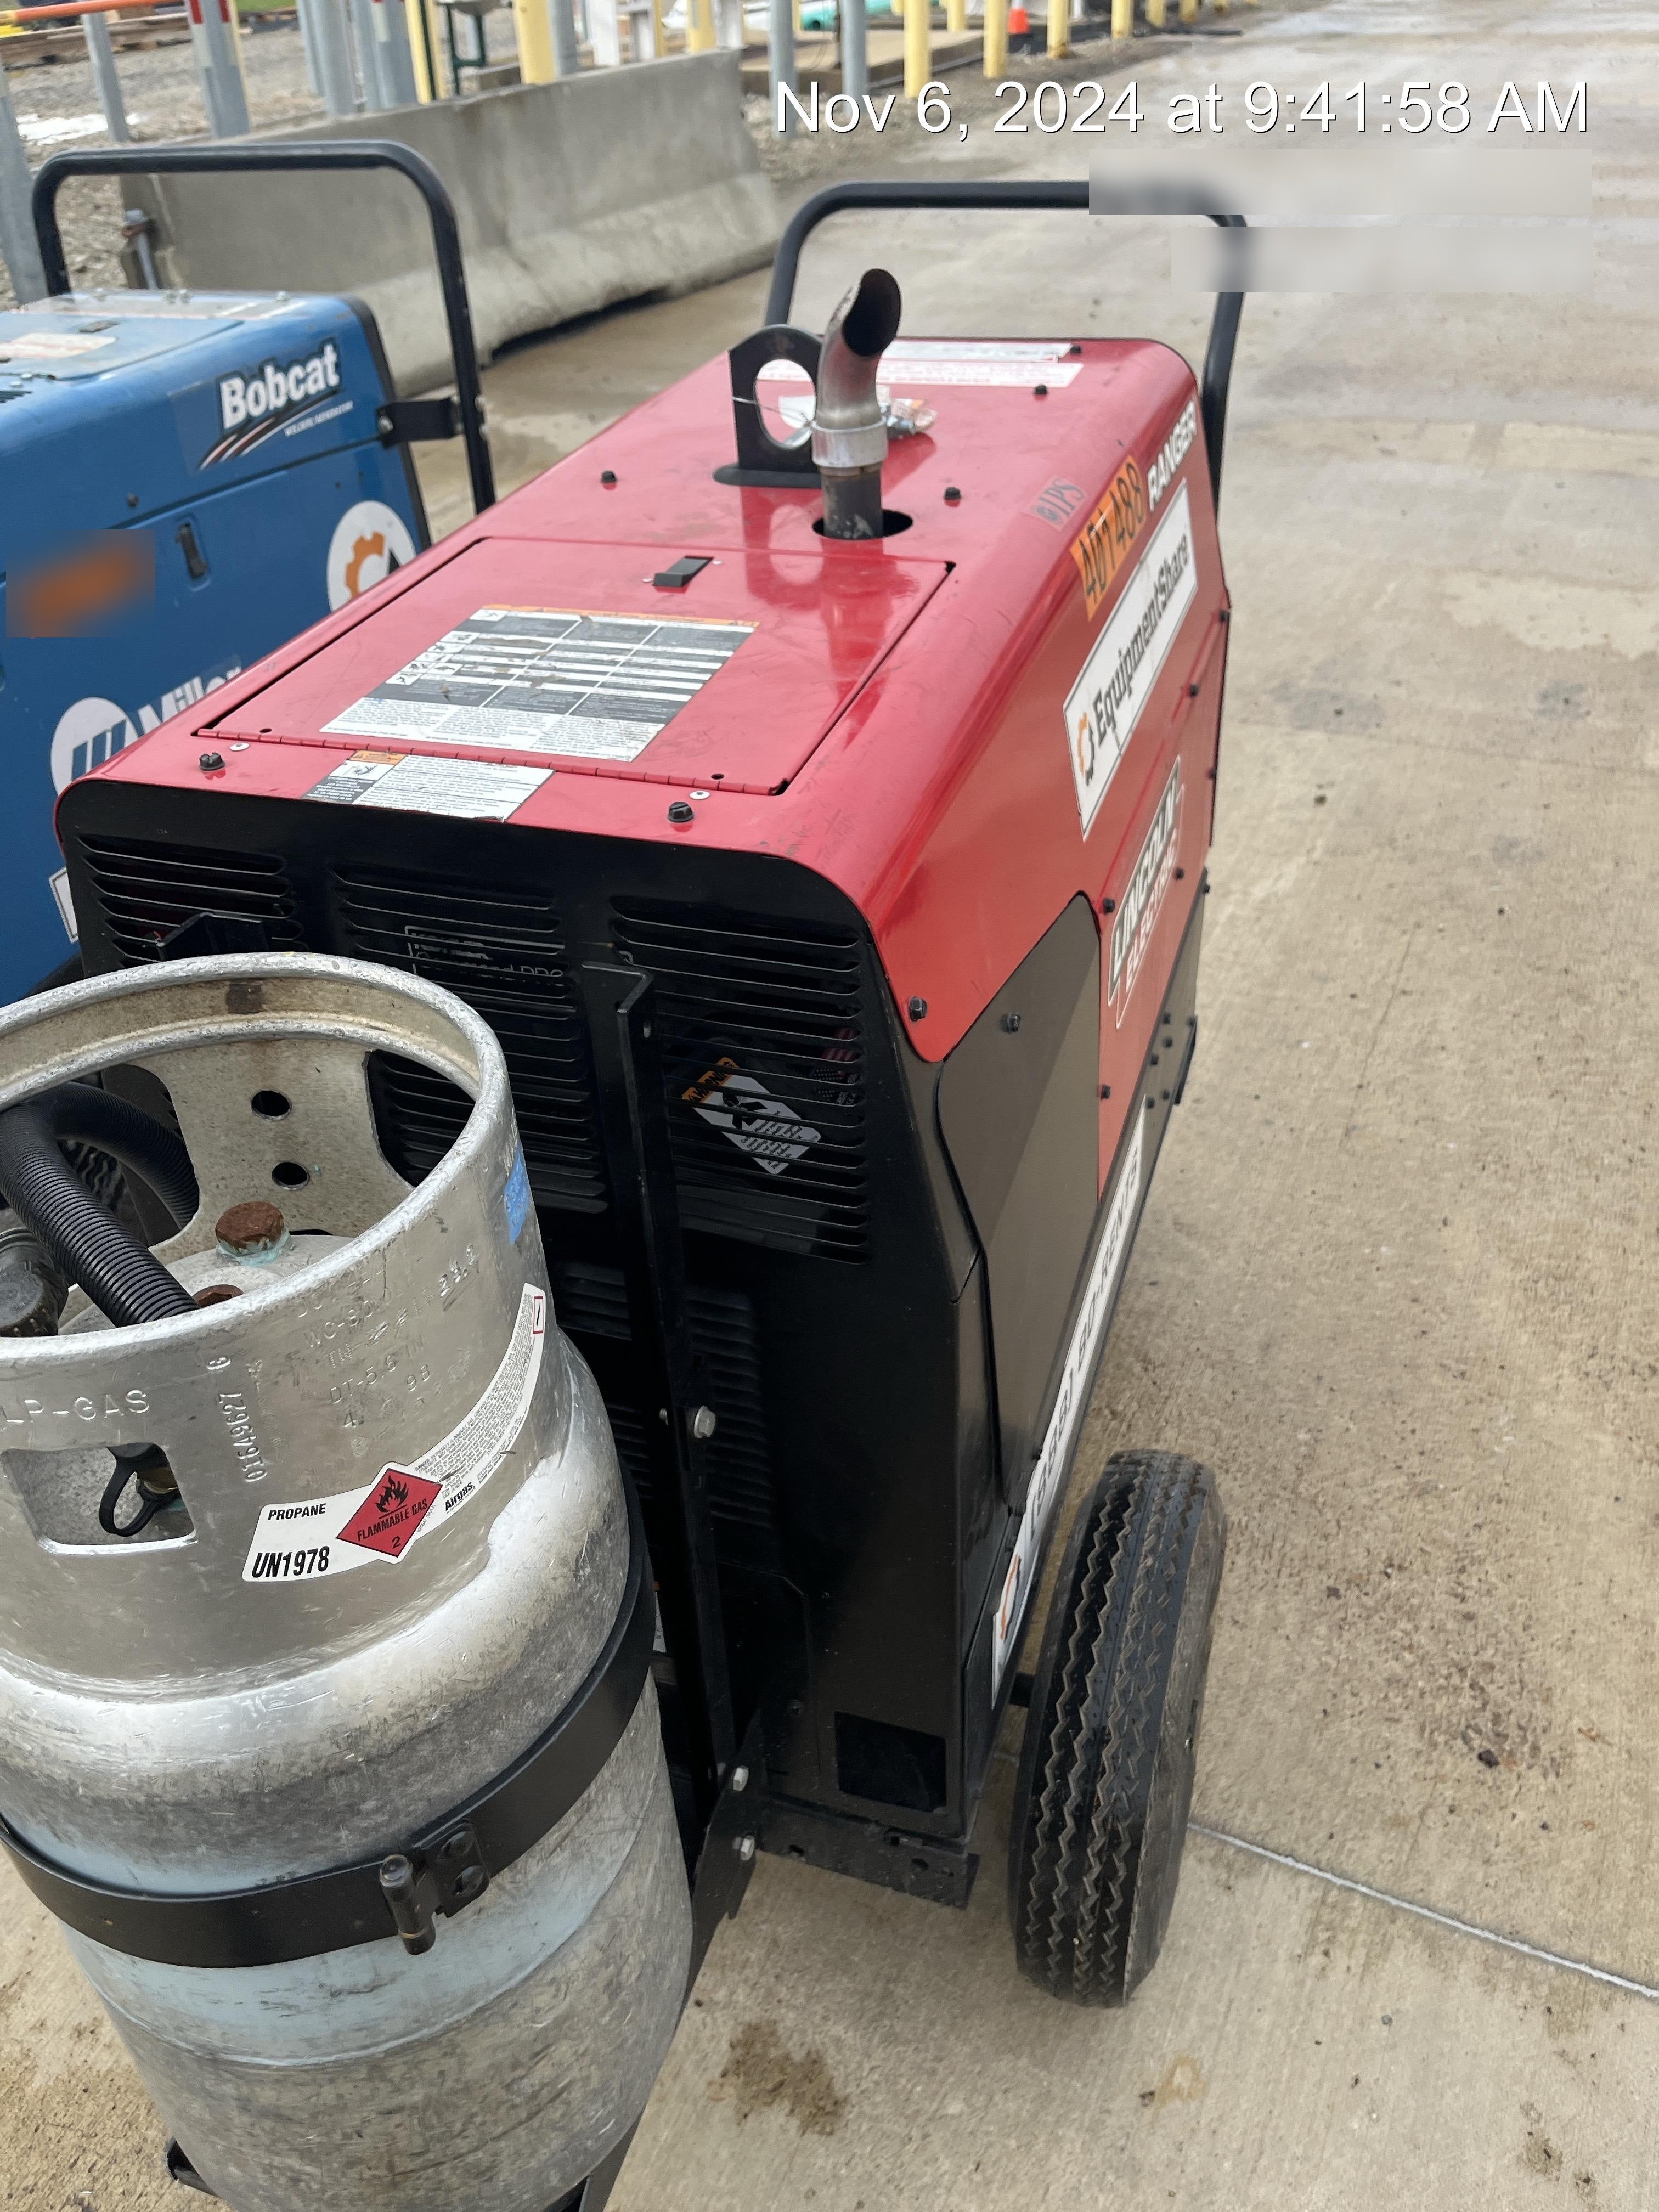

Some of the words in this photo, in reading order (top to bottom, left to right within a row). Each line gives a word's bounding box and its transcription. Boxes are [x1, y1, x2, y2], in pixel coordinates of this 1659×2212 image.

[220, 344, 339, 429] Bobcat
[1147, 399, 1197, 512] RANGER
[1093, 532, 1190, 748] EquipmentShare
[1113, 775, 1178, 984] LINCOLN
[2, 1389, 150, 1424] LP-GAS
[268, 1503, 326, 1521] PROPANE
[445, 1481, 474, 1511] Airgas
[357, 1508, 410, 1542] FLAMMABLE
[411, 1498, 428, 1517] GAS
[251, 1545, 331, 1578] UN1978
[391, 1536, 402, 1549] 2
